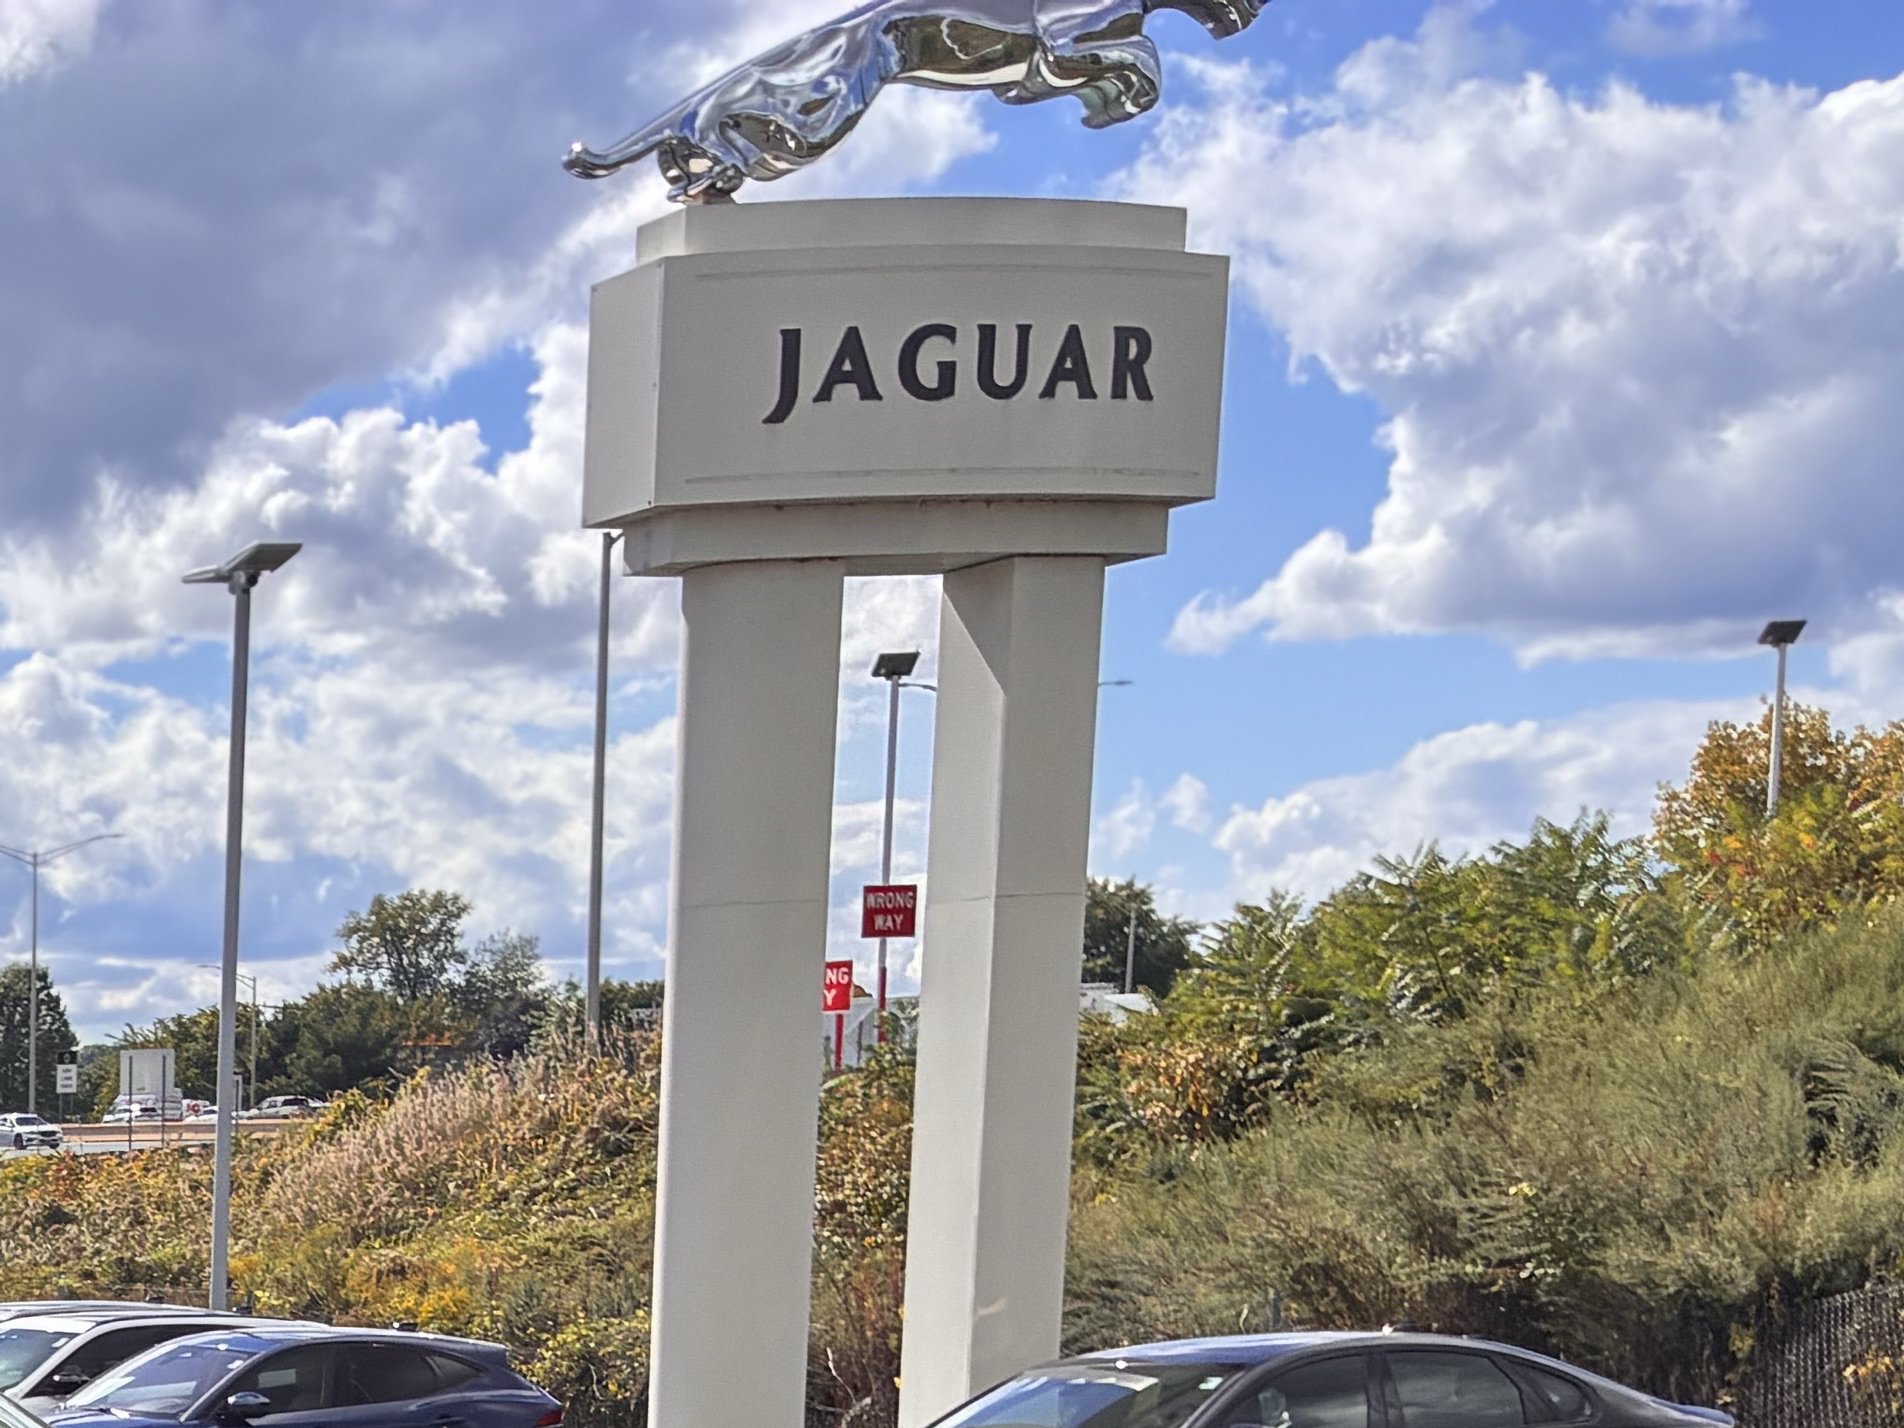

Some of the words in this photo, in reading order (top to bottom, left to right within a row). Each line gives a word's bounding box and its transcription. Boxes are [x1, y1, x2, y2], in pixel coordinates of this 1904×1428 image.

[761, 323, 1154, 424] JAGUAR
[865, 891, 914, 909] WRONG
[873, 914, 903, 931] WAY
